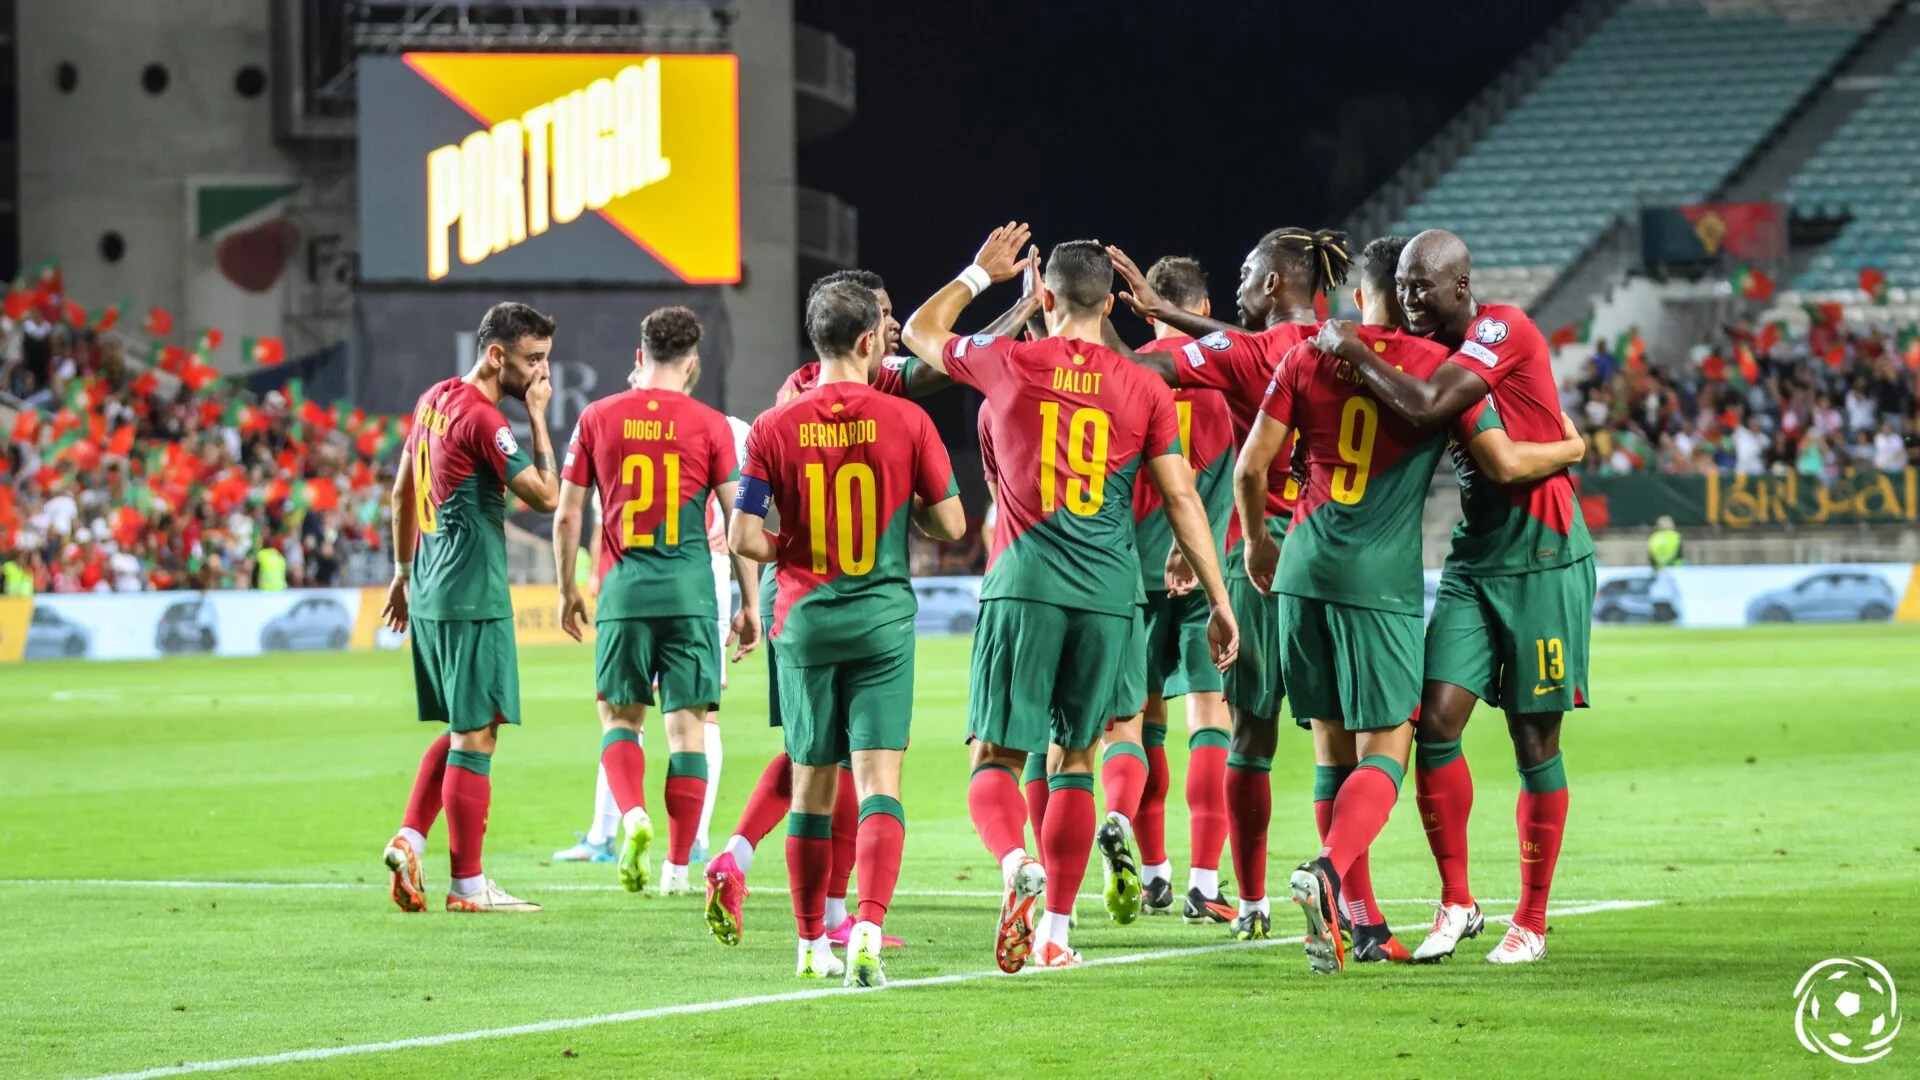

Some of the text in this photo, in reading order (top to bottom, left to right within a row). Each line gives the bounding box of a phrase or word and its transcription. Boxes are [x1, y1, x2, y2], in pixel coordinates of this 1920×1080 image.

[428, 56, 671, 280] PORTUGAL
[1053, 366, 1103, 395] DALOT
[623, 419, 677, 441] DIOGO J.
[800, 419, 876, 447] BERNARDO
[1039, 401, 1109, 516] 19
[1330, 395, 1378, 505] 9
[416, 439, 437, 533] 8
[622, 453, 680, 547] 21
[805, 462, 876, 576] 10
[1536, 637, 1565, 681] 13
